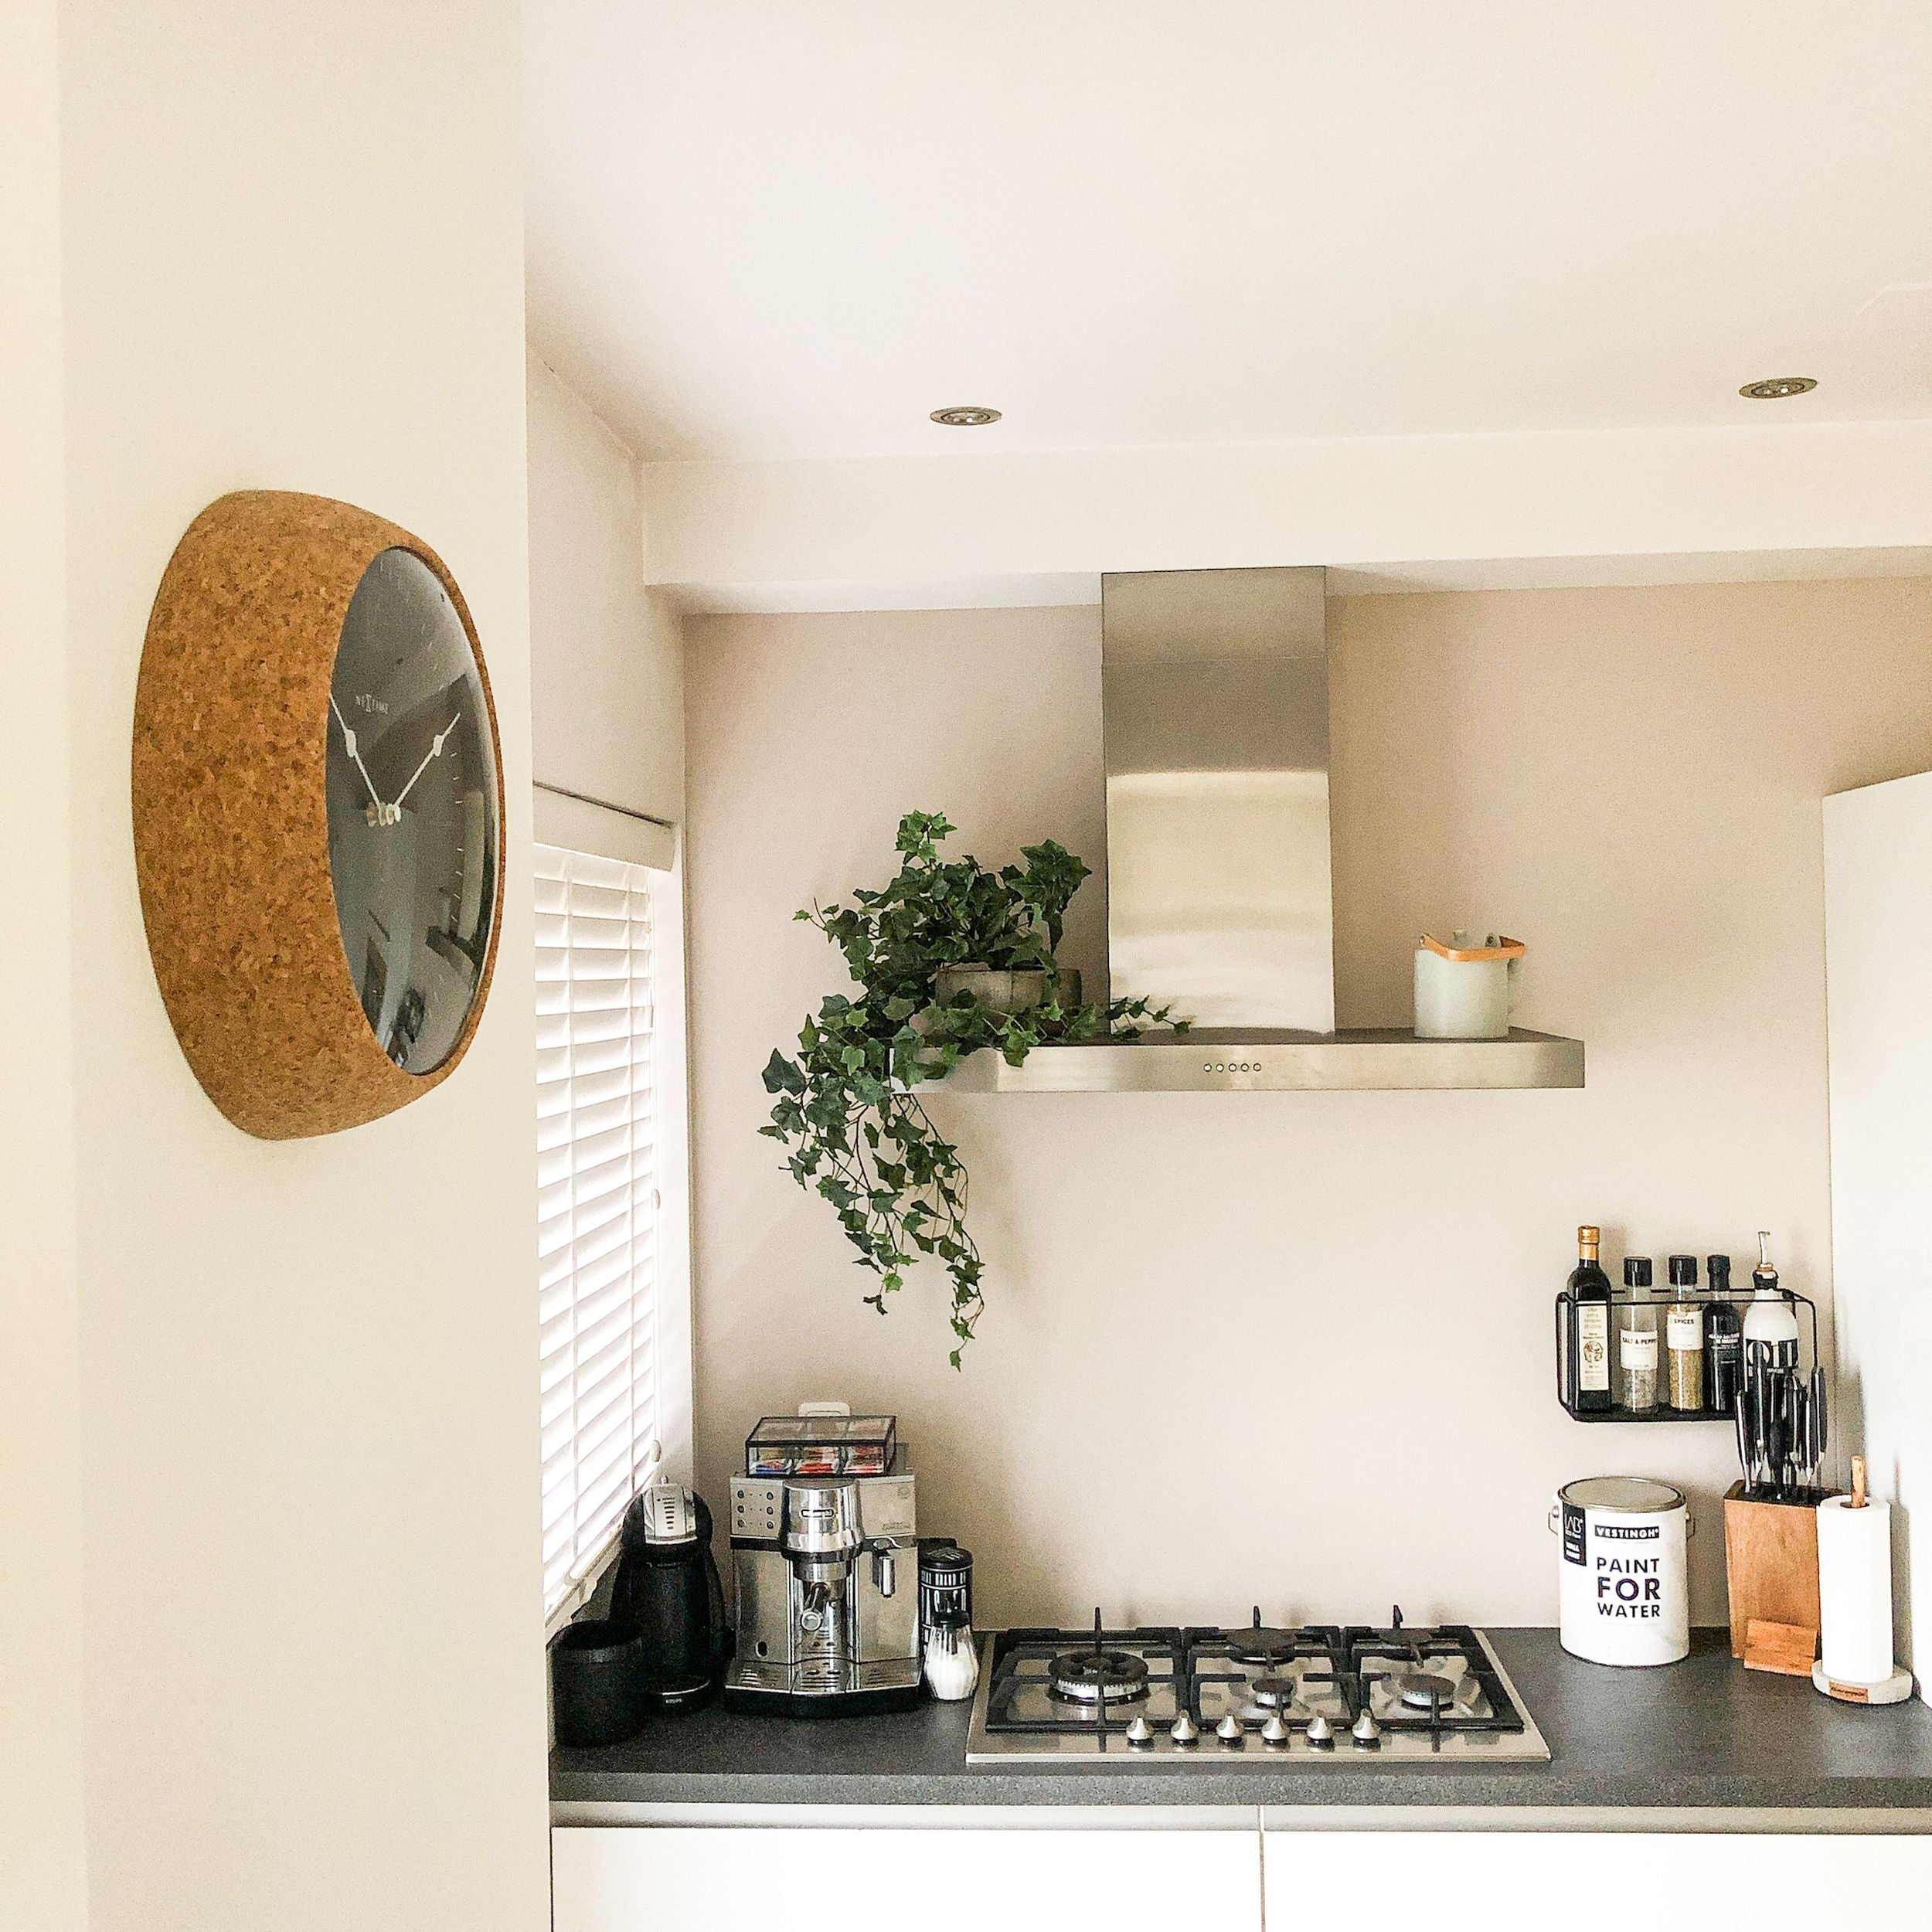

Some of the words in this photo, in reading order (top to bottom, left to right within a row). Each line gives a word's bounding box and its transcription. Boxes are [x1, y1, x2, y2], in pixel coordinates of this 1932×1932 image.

[1597, 1556, 1660, 1573] PAINT
[1597, 1576, 1661, 1601] FOR
[1597, 1602, 1661, 1617] WATER
